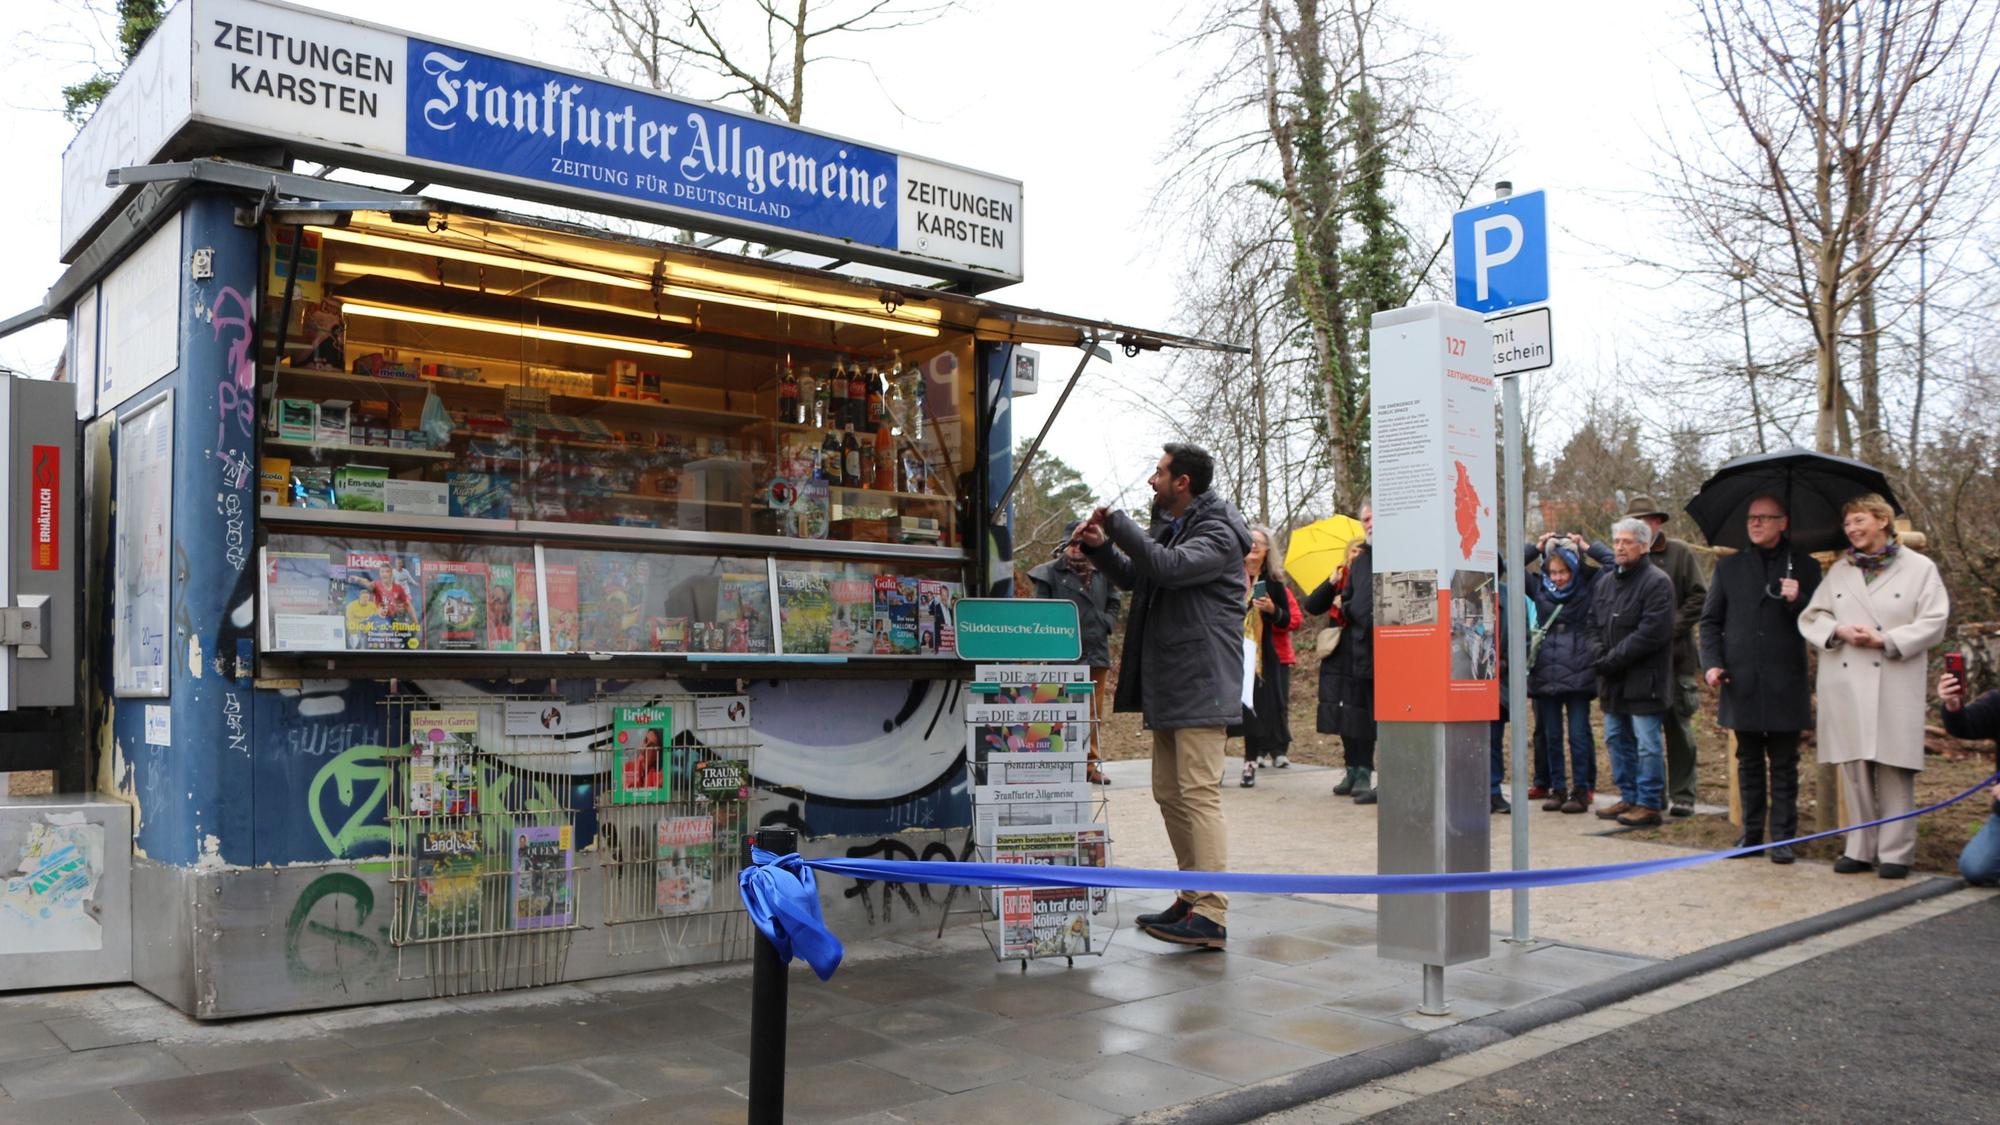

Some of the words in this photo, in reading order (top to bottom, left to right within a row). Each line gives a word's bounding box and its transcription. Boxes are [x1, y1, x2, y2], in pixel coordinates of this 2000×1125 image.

[213, 20, 393, 85] ZEITUNGEN
[231, 63, 378, 118] KARSTEN
[422, 51, 677, 162] Frankfurter
[680, 113, 887, 209] Allgemeine
[551, 157, 629, 187] ZEITUNG
[635, 172, 668, 195] FÜR
[673, 183, 791, 219] DEUTSCHLAND
[907, 179, 1013, 223] ZEITUNGEN
[917, 211, 1004, 250] KARSTEN
[1474, 214, 1524, 302] P
[1493, 329, 1515, 345] mit
[1446, 336, 1467, 357] 127
[379, 369, 416, 379] mentos
[1447, 369, 1493, 386] ZEITUNGSKIOSK
[347, 478, 384, 488] Em-eukal
[37, 488, 51, 543] ERHÄLTLICH
[40, 544, 51, 566] HIER
[875, 578, 897, 590] Gala
[960, 621, 1033, 634] Süddeutsche
[1033, 623, 1075, 639] Zeitung
[1000, 671, 1023, 683] DIE
[1040, 671, 1069, 683] ZEIT
[413, 717, 444, 727] Wohnen
[449, 716, 475, 727] Garten
[991, 710, 1014, 722] DIE
[1033, 710, 1061, 721] ZEIT
[702, 768, 741, 778] TRAUM-
[702, 778, 741, 788] GARTEN
[994, 790, 1035, 800] Frankfurter
[1035, 788, 1074, 800] Allgemeine
[1033, 901, 1048, 913] Ich
[1049, 900, 1067, 912] traf
[1069, 899, 1089, 911] den
[1033, 914, 1066, 927] Kölner
[1034, 928, 1057, 942] Wolf
